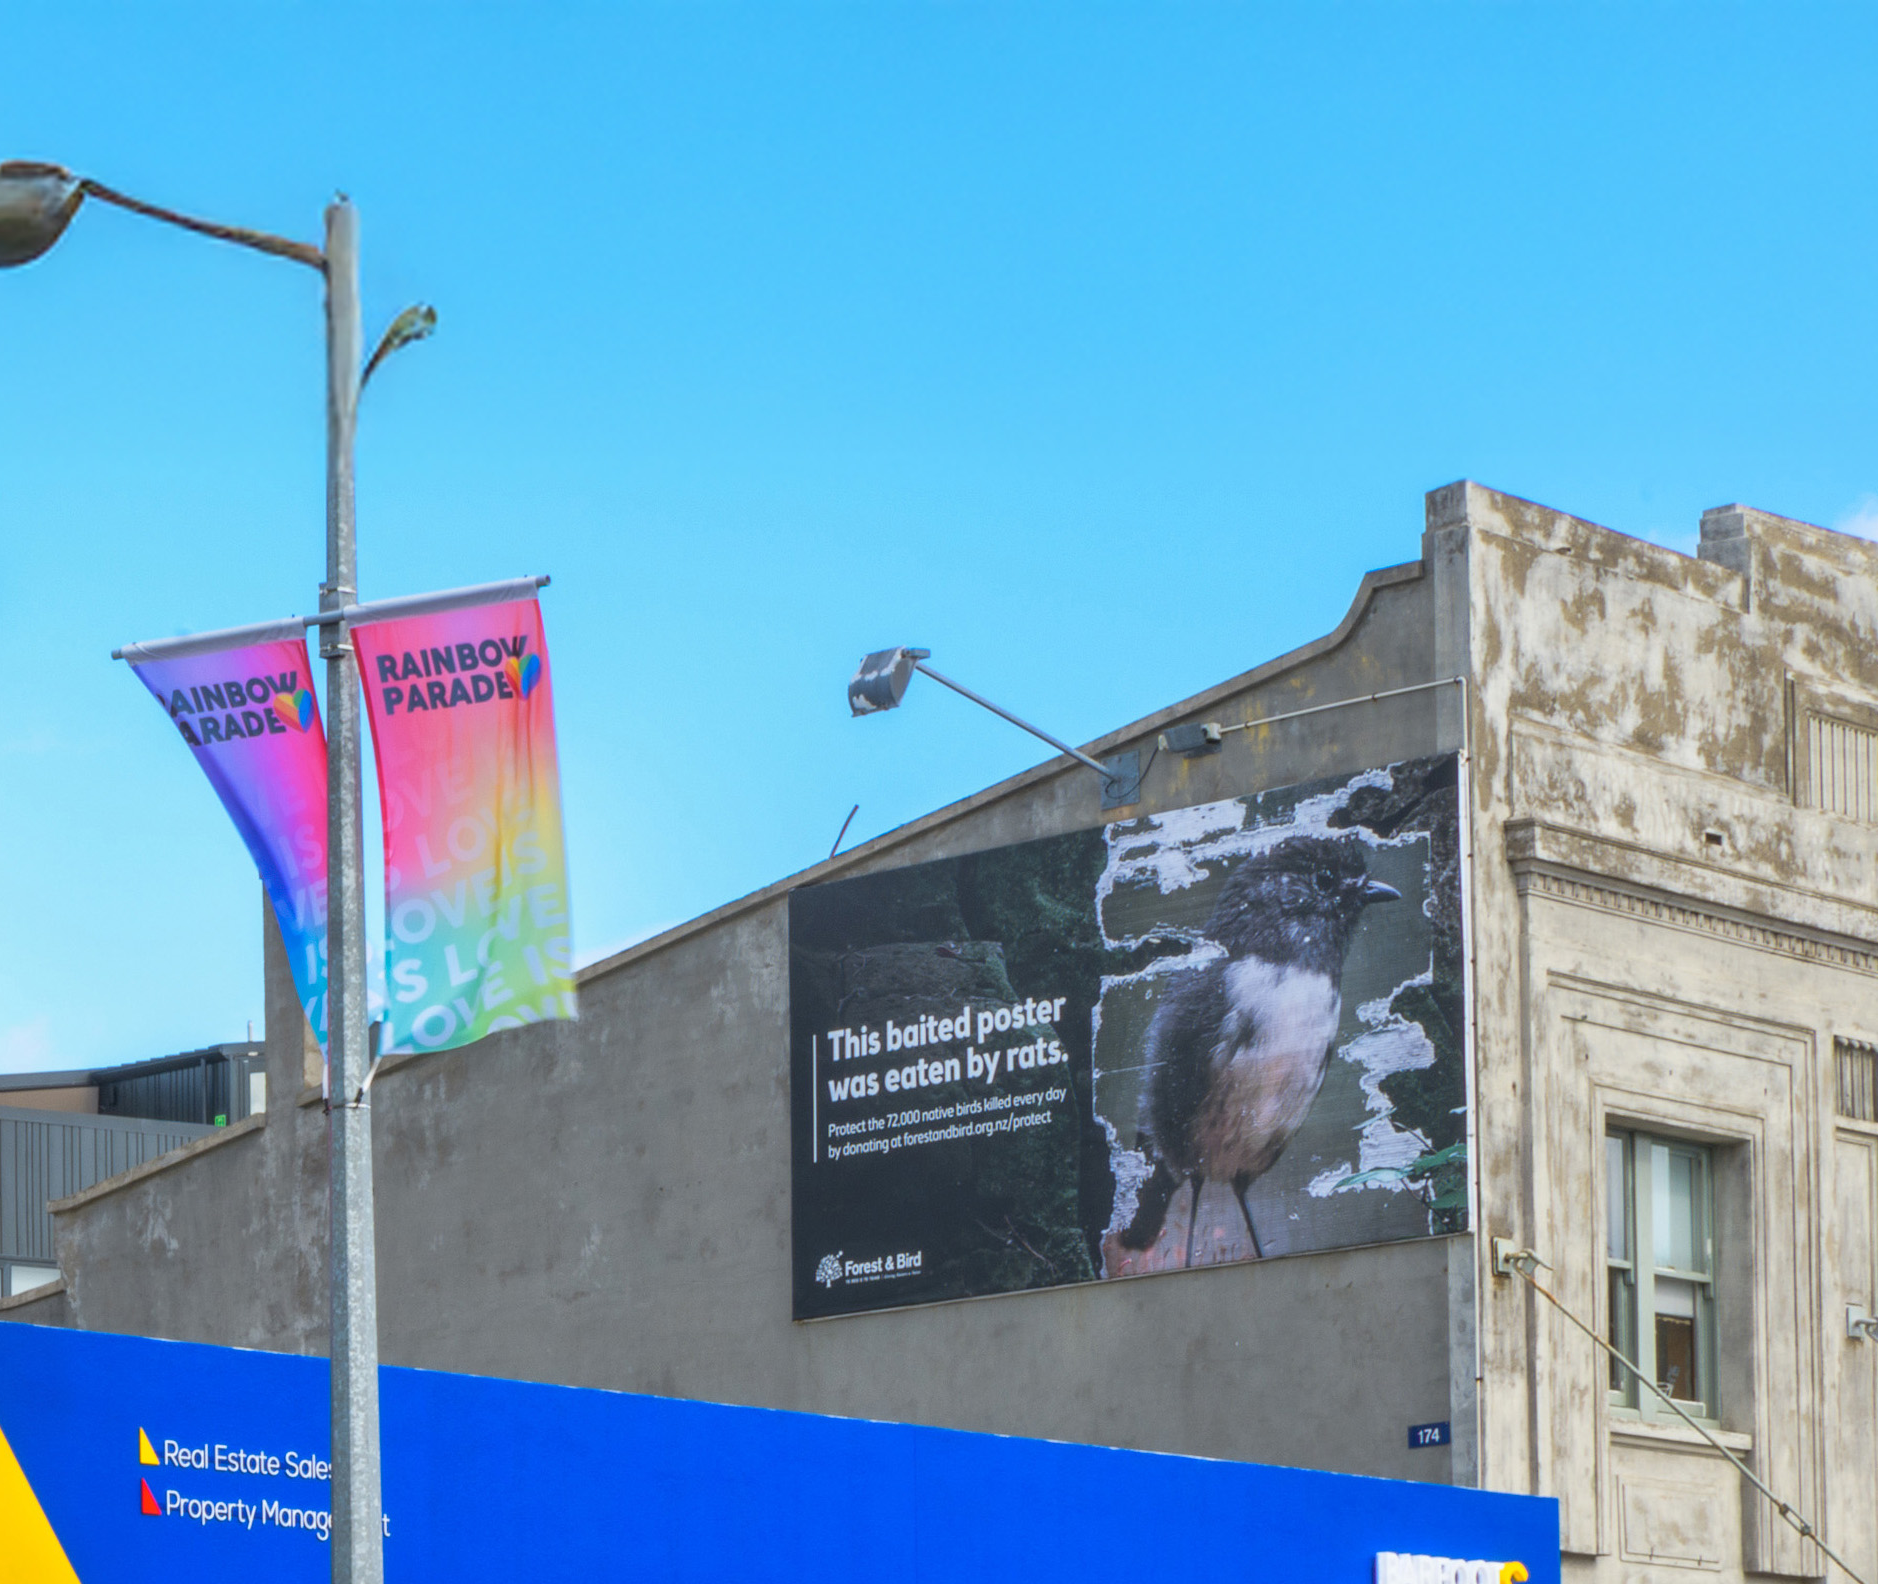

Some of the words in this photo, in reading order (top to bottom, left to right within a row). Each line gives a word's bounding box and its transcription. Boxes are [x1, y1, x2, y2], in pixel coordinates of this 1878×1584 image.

[376, 635, 527, 683] RAINBOW
[157, 671, 298, 718] AINBOW
[382, 671, 513, 715] PARADE
[180, 705, 287, 747] ARADE
[383, 868, 502, 950] OVE
[828, 1025, 881, 1061] This
[886, 1006, 971, 1052] baited
[977, 997, 1067, 1044] poster
[828, 1072, 880, 1102] was
[884, 1057, 961, 1093] eaten
[966, 1046, 1001, 1084] by
[1006, 1037, 1069, 1072] rats.
[828, 1120, 866, 1138] Protect
[867, 1116, 885, 1131] the
[886, 1109, 920, 1129] 72,000
[922, 1104, 954, 1122] native
[956, 1099, 982, 1116] birds
[983, 1094, 1012, 1111] killed
[1013, 1091, 1044, 1108] every
[1045, 1086, 1067, 1103] day
[828, 1145, 842, 1161] by
[843, 1138, 889, 1156] donating
[890, 1135, 902, 1148] at
[903, 1110, 1052, 1147] forestandbird.org.nz/protect
[845, 1257, 883, 1277] Forest
[885, 1255, 894, 1271] &
[896, 1250, 922, 1270] Bird
[164, 1439, 209, 1469] Real
[214, 1444, 280, 1476] Estate
[1417, 1427, 1440, 1444] 174
[166, 1489, 256, 1530] Property
[261, 1499, 391, 1541] Managt
